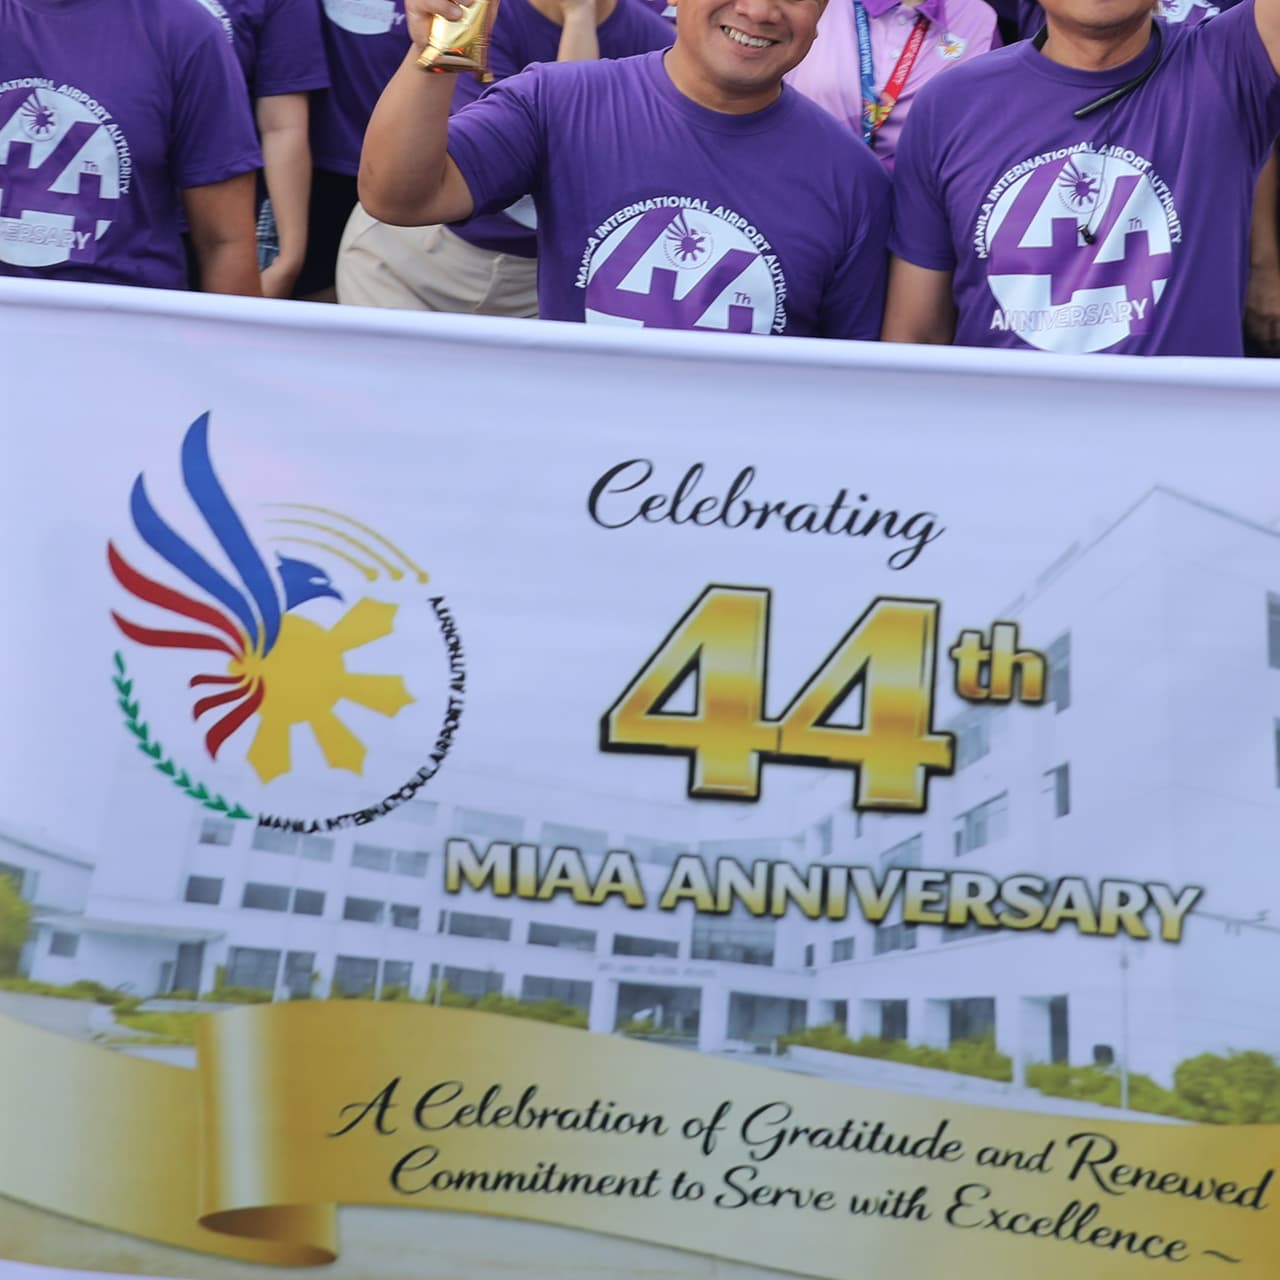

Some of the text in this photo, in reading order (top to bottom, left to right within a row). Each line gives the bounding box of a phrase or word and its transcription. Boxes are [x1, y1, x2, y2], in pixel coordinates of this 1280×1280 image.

[56, 84, 112, 122] AIRPORT
[106, 123, 132, 195] AUTHORITY
[974, 200, 993, 259] MANILA
[987, 142, 1096, 202] INTERNATIONAL
[1147, 170, 1182, 244] AUTHORITY
[595, 196, 711, 240] INTERNATIONAL
[712, 205, 772, 253] AIRPORT
[765, 254, 787, 334] AUTHORITY
[734, 291, 751, 306] Th
[990, 298, 1148, 332] ANNIVERSARY
[587, 457, 946, 571] Celebrating
[444, 838, 1204, 944] MIAA ANNIVERSARY
[324, 1075, 1276, 1211] A Celebration of Gratitude and Renewed
[388, 1143, 1191, 1265] Commitment to Serve with Excellence
